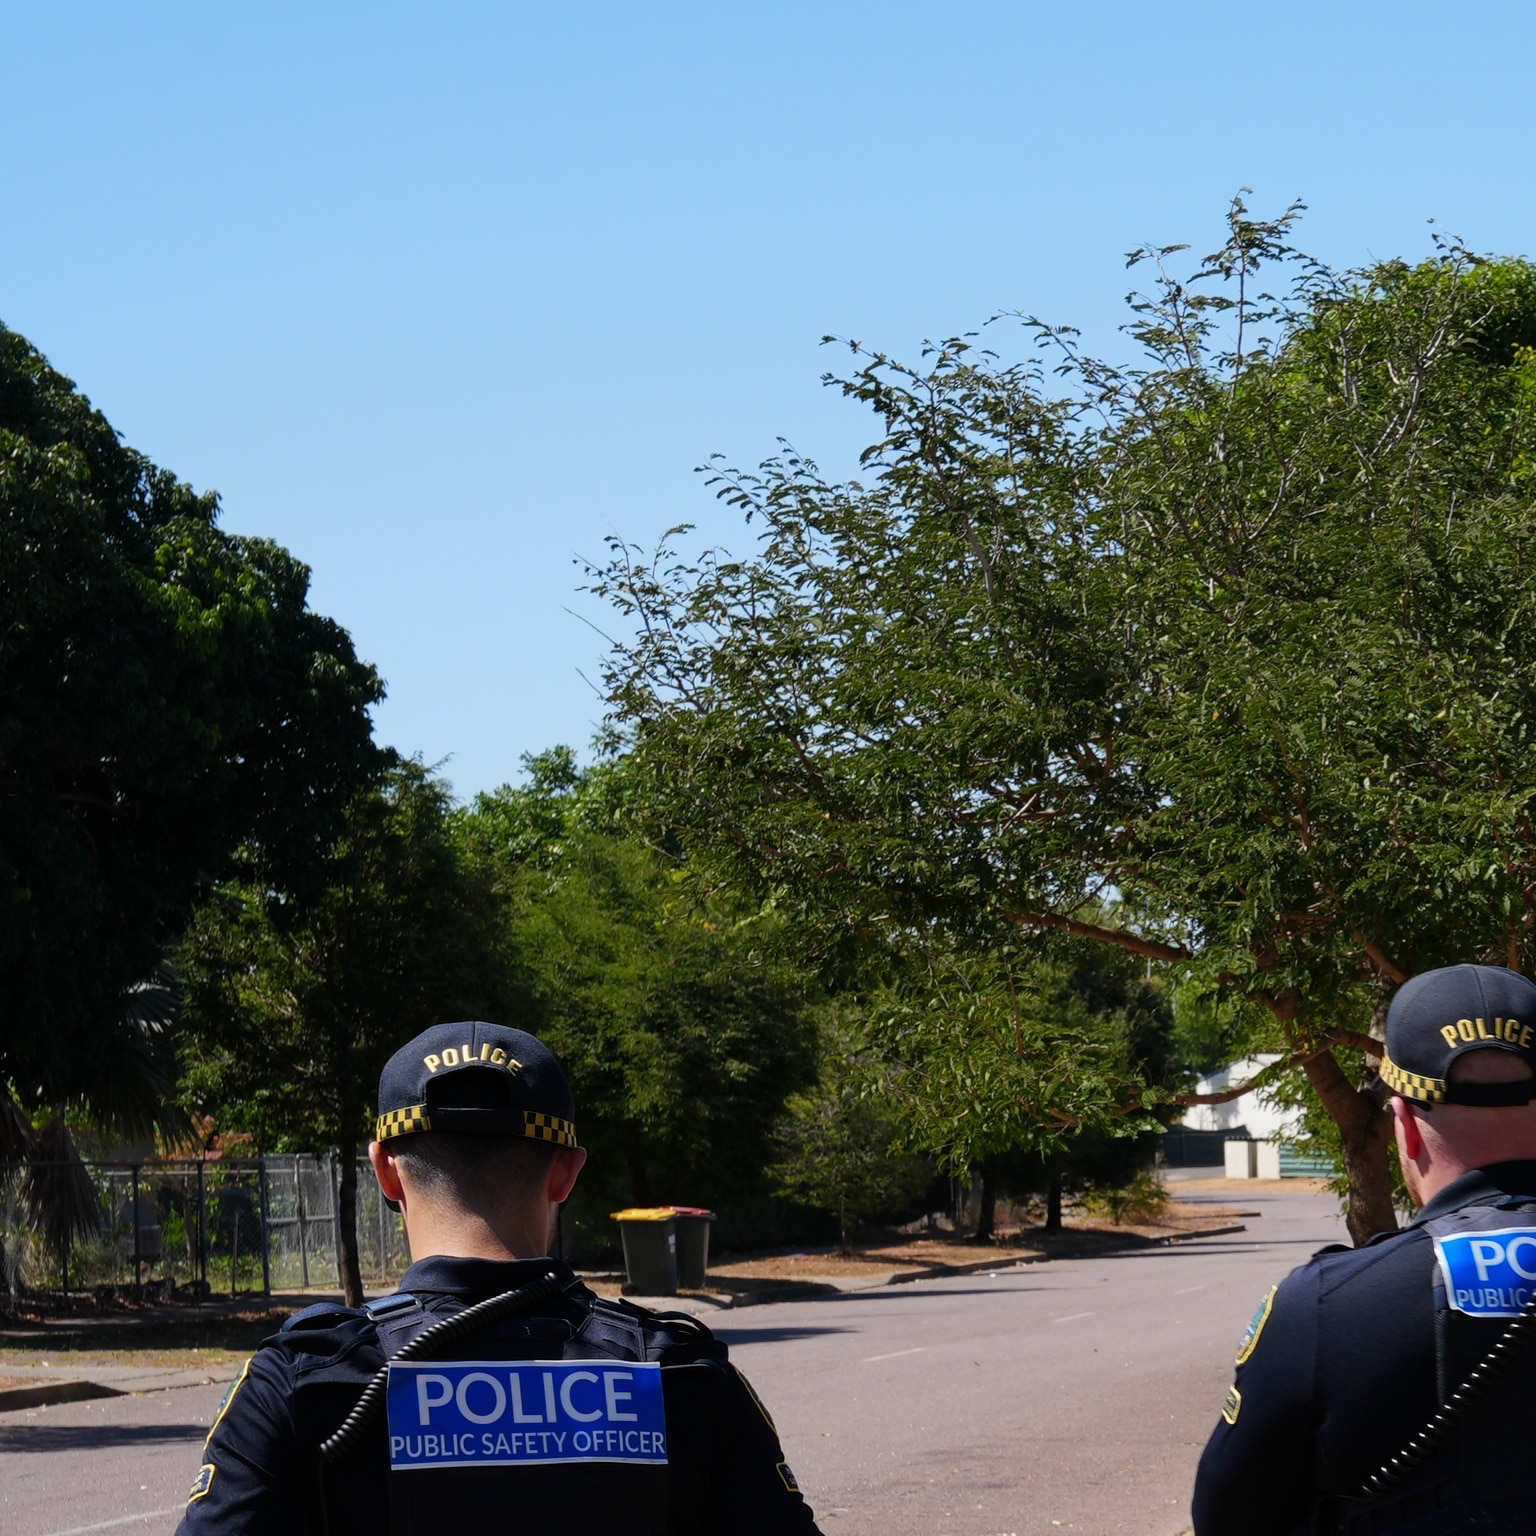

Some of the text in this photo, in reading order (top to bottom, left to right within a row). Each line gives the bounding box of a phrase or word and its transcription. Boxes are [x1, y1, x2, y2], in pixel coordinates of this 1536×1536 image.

[1440, 1017, 1534, 1048] POLICE
[423, 1043, 522, 1077] POLICE
[1455, 1287, 1527, 1309] PUBLIC
[415, 1371, 638, 1425] POLICE
[391, 1430, 666, 1458] PUBLIC SAFETY OFFICER
